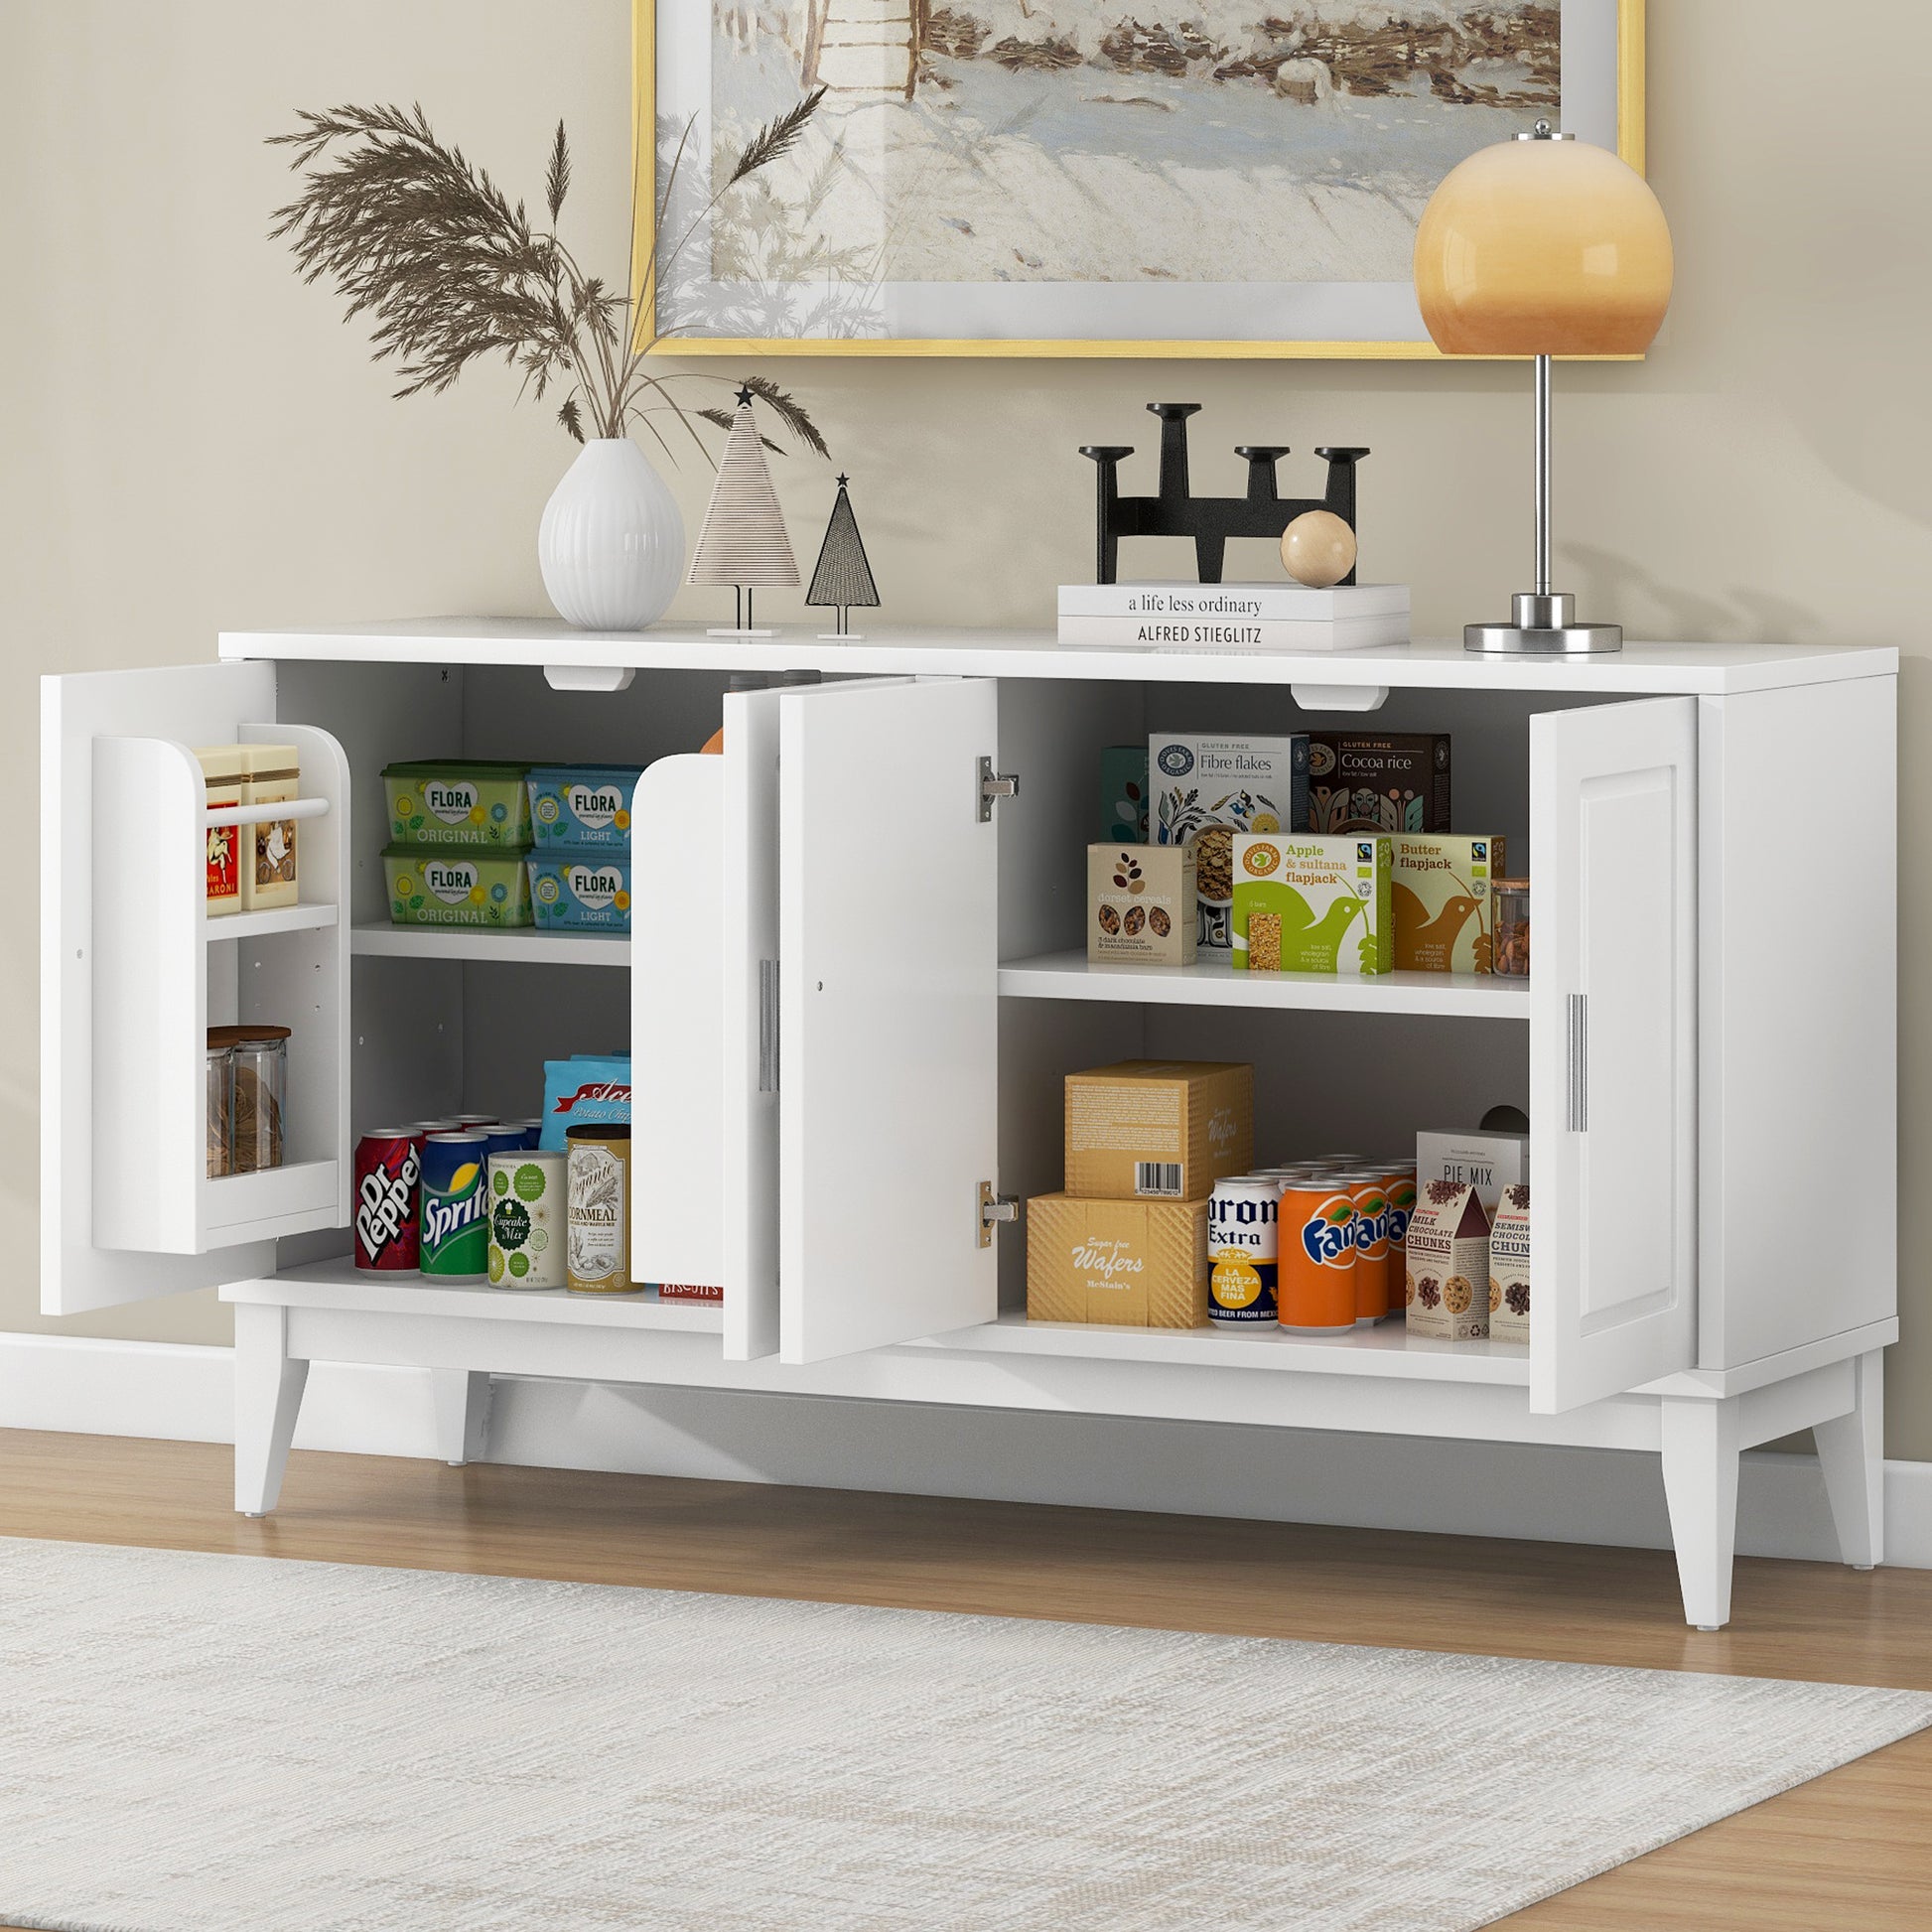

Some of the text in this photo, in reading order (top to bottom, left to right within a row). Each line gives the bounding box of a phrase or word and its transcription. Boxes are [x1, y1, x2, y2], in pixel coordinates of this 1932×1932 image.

[1128, 594, 1263, 617] a life less ordinary
[1138, 625, 1262, 644] ALFRED STIEGLITZ
[1200, 754, 1272, 771] Fibre flakes
[1341, 753, 1412, 769] Cocoa rice
[431, 790, 473, 808] FLORA
[575, 794, 617, 812] FLORA
[417, 829, 488, 844] ORIGINAL
[580, 831, 612, 841] LIGHT
[1286, 844, 1324, 857] Apple
[1400, 844, 1442, 855] Butter
[1286, 859, 1347, 871] & sultana
[1400, 858, 1451, 871] flapjack
[431, 871, 473, 888] FLORA
[575, 875, 617, 893] FLORA
[1286, 872, 1337, 886] flapjack
[207, 883, 235, 896] ARONI
[1097, 893, 1172, 904] dorset cereals
[417, 908, 488, 923] ORIGINAL
[580, 911, 612, 921] LIGHT
[573, 1107, 631, 1123] Potato Chip
[1444, 1165, 1492, 1186] PIE MIX
[360, 1164, 392, 1216] Dr
[356, 1143, 421, 1262] Pepper
[493, 1214, 528, 1229] Cupcake
[1412, 1215, 1437, 1226] MILK
[501, 1227, 524, 1241] Mix
[1208, 1224, 1262, 1245] Extra
[1408, 1225, 1453, 1238] CHOCOLATE
[1087, 1237, 1130, 1250] Sugar free
[1407, 1234, 1451, 1250] CHUNKS
[1071, 1246, 1145, 1279] Wafers
[1211, 1275, 1259, 1285] CERVEZA
[1220, 1284, 1245, 1293] MAS
